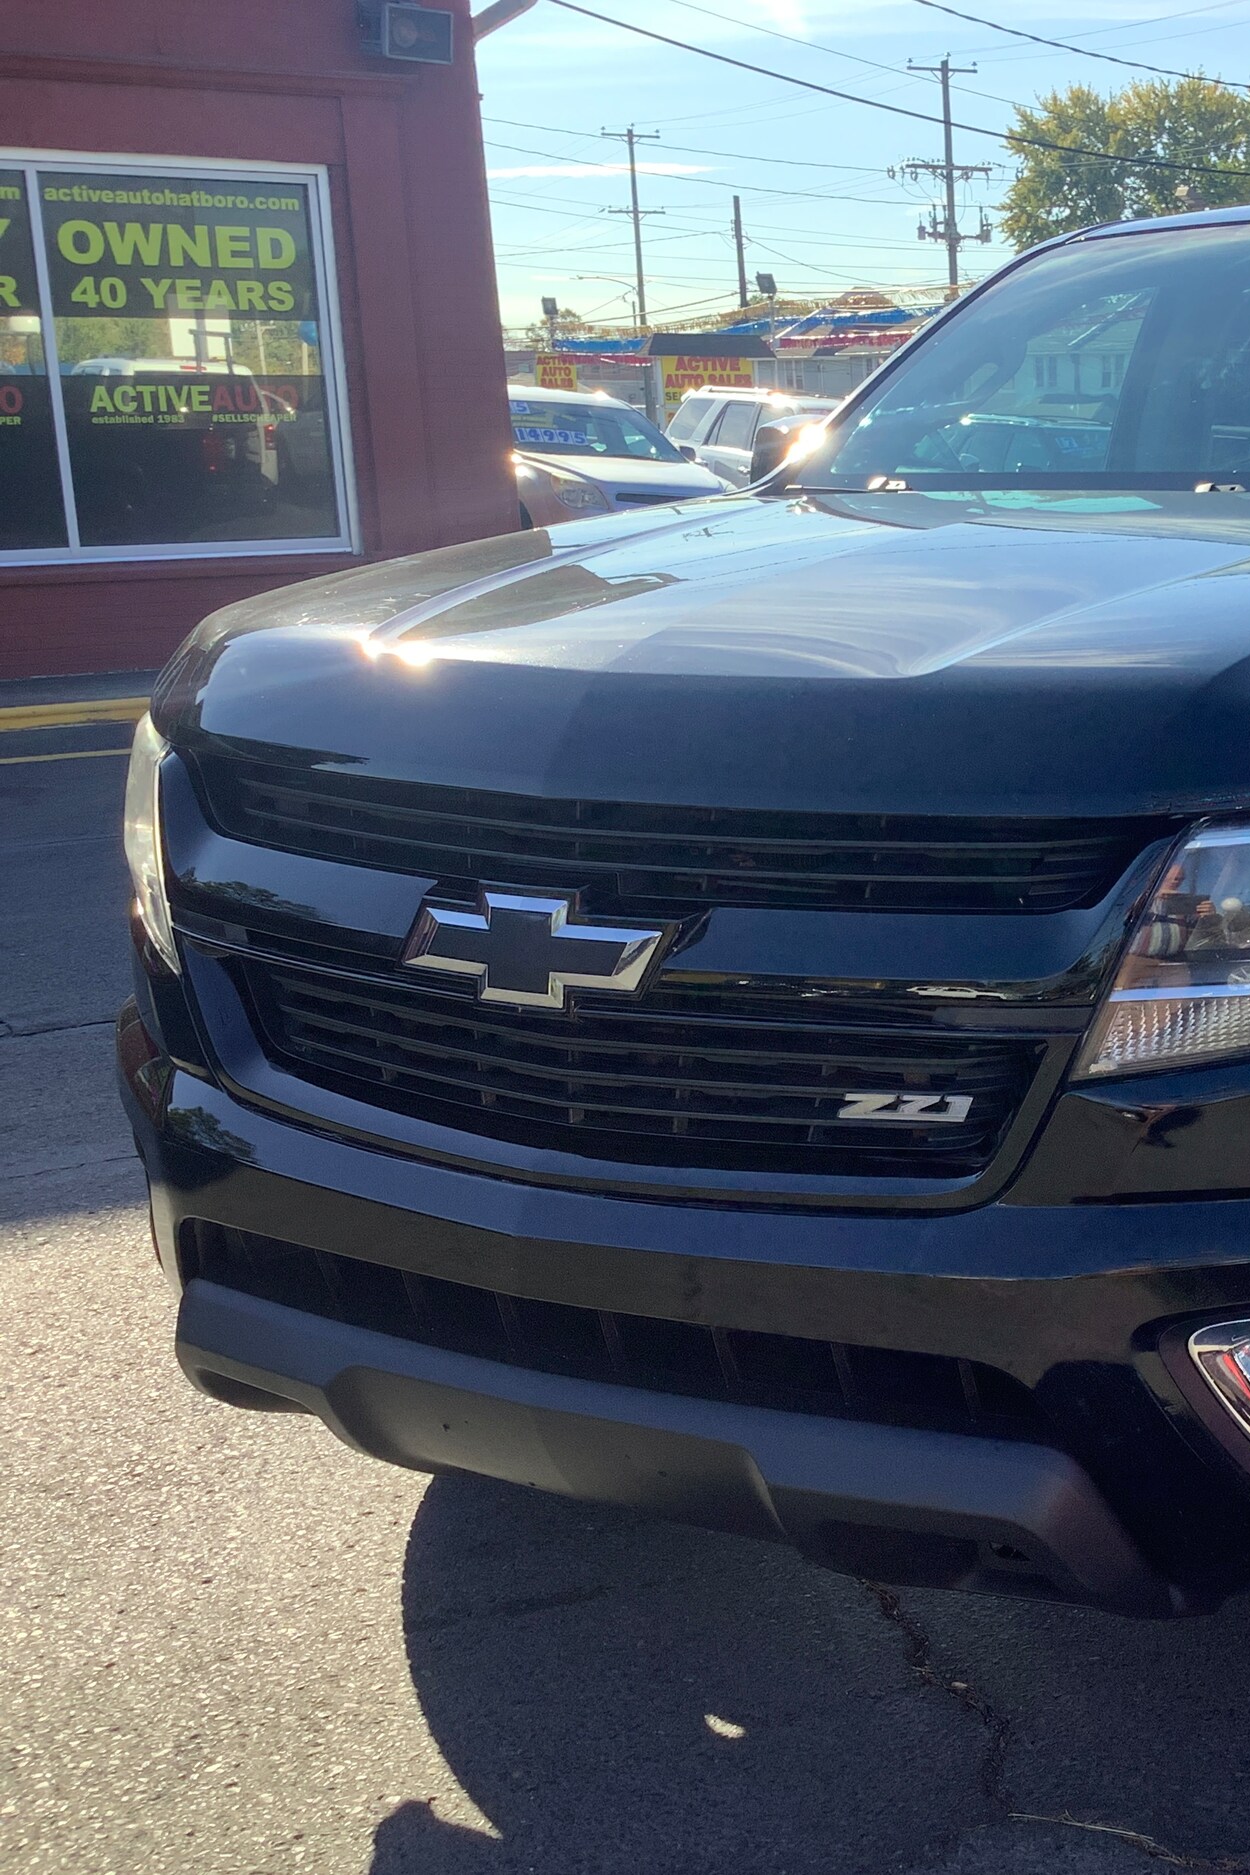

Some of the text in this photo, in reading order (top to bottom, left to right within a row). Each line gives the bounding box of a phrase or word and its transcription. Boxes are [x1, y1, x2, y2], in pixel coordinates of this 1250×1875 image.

[44, 185, 300, 211] activeautohatboro.com
[57, 219, 296, 269] OWNED
[71, 276, 296, 312] 40 YEARS
[536, 356, 575, 366] ACTIVE
[674, 356, 741, 372] ACTIVE
[541, 366, 572, 378] AUTO
[540, 378, 574, 389] SALES
[665, 374, 753, 388] AUTO SALES
[92, 414, 185, 424] established 1983
[838, 1092, 973, 1122] Z71
